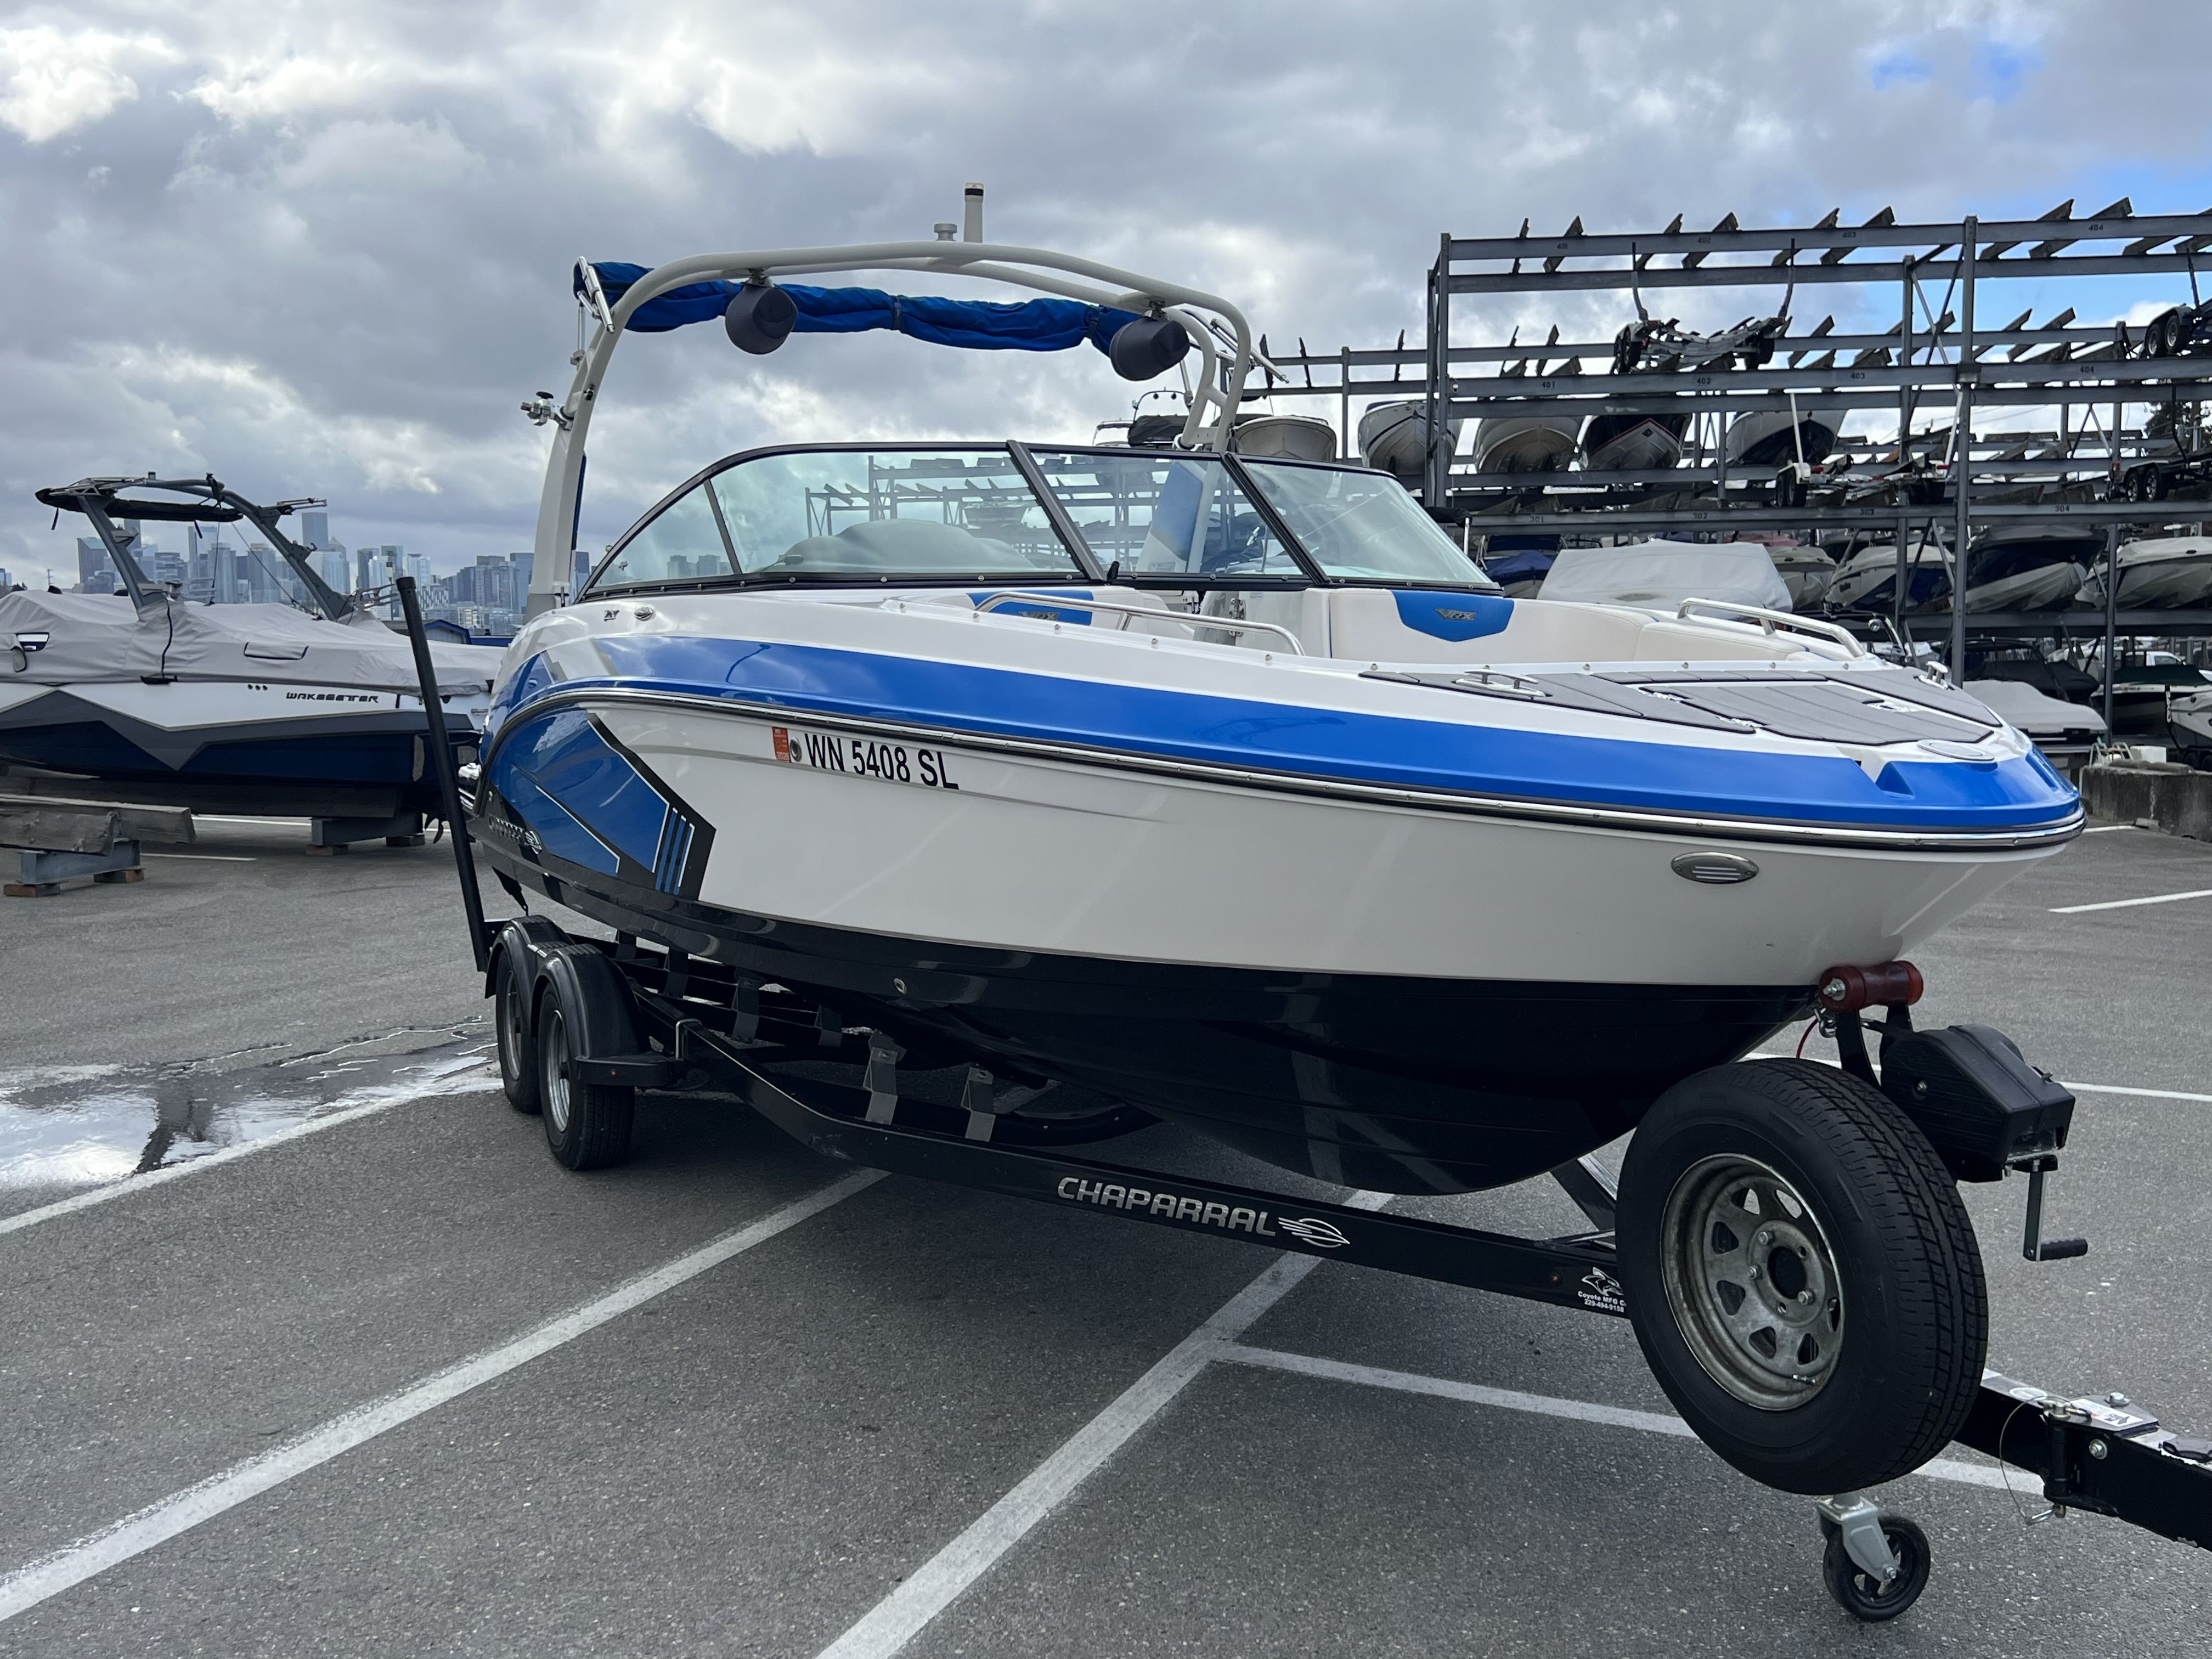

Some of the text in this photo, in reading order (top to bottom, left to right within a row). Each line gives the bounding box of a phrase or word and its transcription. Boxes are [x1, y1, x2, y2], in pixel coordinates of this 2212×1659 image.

[1697, 377, 1712, 385] 402
[1434, 608, 1477, 621] VRX
[286, 692, 379, 703] WAKESETTER
[805, 733, 960, 790] WN 5408 SL
[1057, 1176, 1277, 1237] CHAPARRAL
[1577, 1290, 1601, 1300] Coyote
[1602, 1296, 1618, 1305] MFG
